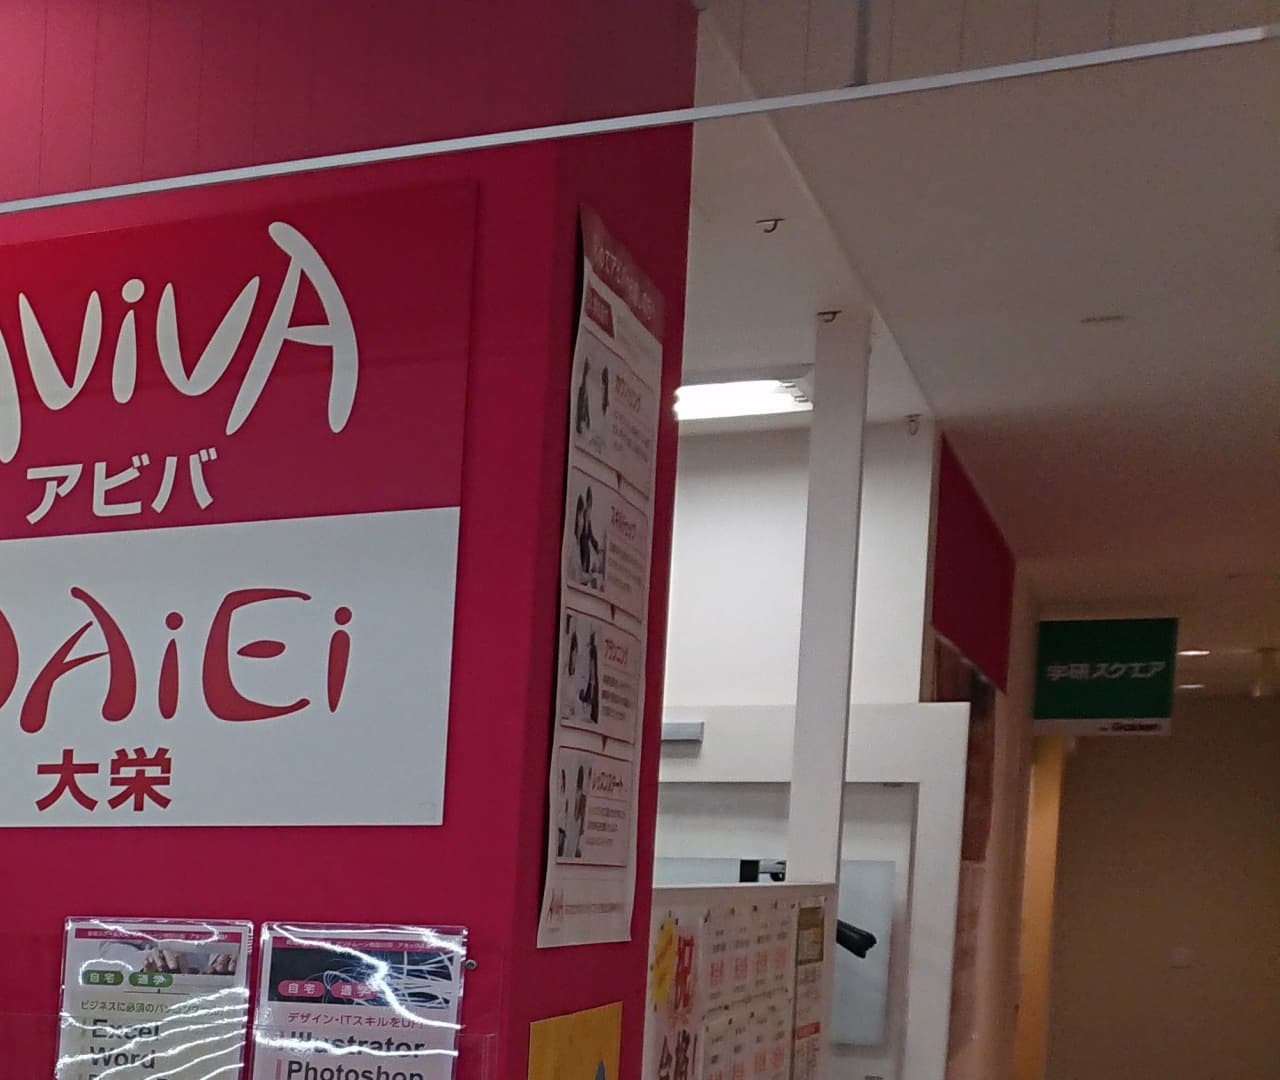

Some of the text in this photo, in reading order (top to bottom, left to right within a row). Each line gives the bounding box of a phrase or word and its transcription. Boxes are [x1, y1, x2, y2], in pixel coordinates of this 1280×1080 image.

[26, 448, 217, 524] アビバ
[35, 747, 172, 812] 大栄
[90, 973, 115, 983] 自宅
[288, 983, 316, 994] 自宅
[92, 1018, 160, 1040] Excel
[90, 1046, 155, 1069] Word
